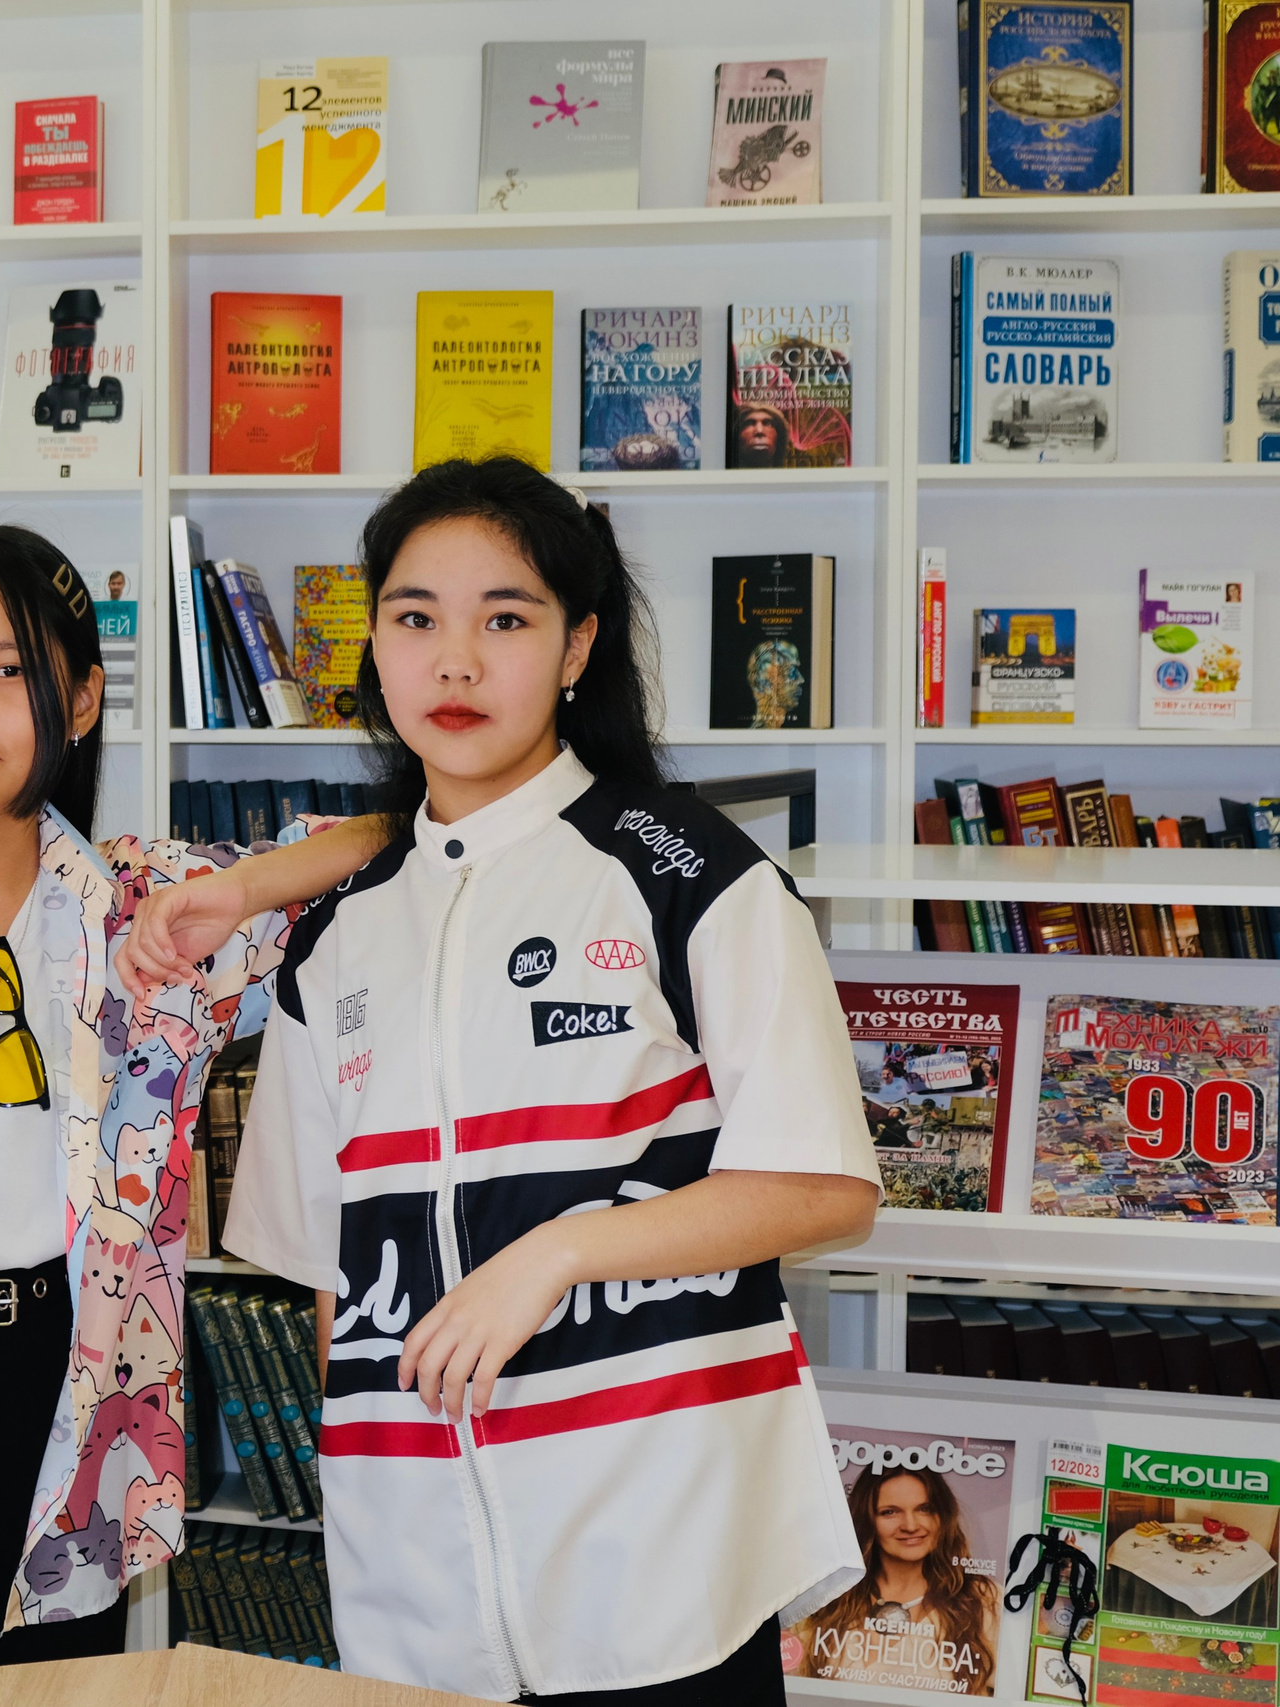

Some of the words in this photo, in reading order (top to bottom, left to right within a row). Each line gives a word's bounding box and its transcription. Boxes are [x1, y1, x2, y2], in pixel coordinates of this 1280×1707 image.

[1018, 12, 1093, 27] ИСТОРИЯ
[283, 86, 323, 112] 12
[322, 96, 382, 105] элементов
[726, 91, 813, 125] МИНСКИЙ
[35, 112, 76, 127] СНАЧАЛА
[320, 109, 382, 120] успешного
[42, 125, 69, 141] ТЫ
[302, 122, 381, 132] менеджмента
[24, 140, 88, 154] ПОБЕЖДАЕШЬ
[23, 156, 30, 167] В
[32, 152, 88, 166] РАЗДЕВАЛКЕ
[1036, 267, 1093, 280] МЮЛЛЕР
[987, 290, 1044, 311] САМЫЙ
[1050, 292, 1112, 313] ПОЛНЫЙ
[593, 310, 698, 329] РИЧАРД
[740, 305, 849, 326] РИЧАРД
[1002, 320, 1096, 332] АНГЛО-РУССКИЙ
[596, 331, 698, 350] ДОКИНЗ
[739, 326, 850, 348] ДОКИНЗ
[987, 331, 1112, 344] РУССКО-АНГЛИЙСКИЙ
[227, 343, 333, 358] ПАЛЕОНТОЛОГИЯ
[433, 341, 542, 355] ПАЛЕОНТОЛОГИЯ
[739, 348, 850, 367] РАССКАЗ
[15, 344, 135, 378] ФОТОГРАФИЯ
[985, 352, 1110, 386] СЛОВАРЬ
[592, 364, 629, 382] НА
[633, 363, 699, 382] ГОРУ
[739, 367, 850, 390] ПРЕДКА
[592, 384, 699, 395] НЕВЕРОЯТНОСТИ
[739, 388, 850, 400] ПАЛОМНИЧЕСТВО
[752, 607, 803, 615] РАССТРОЕННАЯ
[1156, 610, 1211, 623] Вылечи
[238, 610, 268, 681] ГАСТРО-КНИГА
[932, 600, 943, 683] АНГЛО-РУССКИЙ
[992, 667, 1064, 678] ФРАНЦУЗСКО-
[998, 679, 1056, 691] РУССКИЙ
[992, 701, 1062, 712] СЛОВАРЬ
[1188, 702, 1232, 710] ГАСТРИТ
[591, 941, 637, 969] AAA
[873, 989, 967, 1007] ЧЕСТЬ
[546, 1006, 618, 1039] Coke!
[1056, 1008, 1222, 1037] ТЕХНИКА
[1086, 1023, 1268, 1057] МОЛОДЕЖИ
[1126, 1058, 1160, 1072] 1933
[1125, 1075, 1265, 1166] 90
[1234, 1111, 1249, 1131] ЛЕТ
[1228, 1170, 1265, 1183] 2023
[1051, 1458, 1100, 1478] 12/2023
[1122, 1452, 1269, 1493] Ксюша
[1122, 1480, 1141, 1490] для
[1145, 1483, 1206, 1498] любителей
[1210, 1490, 1270, 1501] рукоделия
[952, 1556, 959, 1567] В
[960, 1557, 997, 1570] ФОКУСЕ
[864, 1616, 936, 1637] КСЕНИЯ
[1111, 1615, 1153, 1628] Готовимся
[1160, 1620, 1204, 1636] Рождеству
[1212, 1626, 1245, 1639] Новому
[1246, 1630, 1267, 1641] году!
[814, 1627, 981, 1675] КУЗНЕЦОВА:
[817, 1665, 834, 1678] «Я
[836, 1666, 877, 1682] ЖИВУ
[878, 1672, 969, 1693] СЧАСТЛИВОЙ
